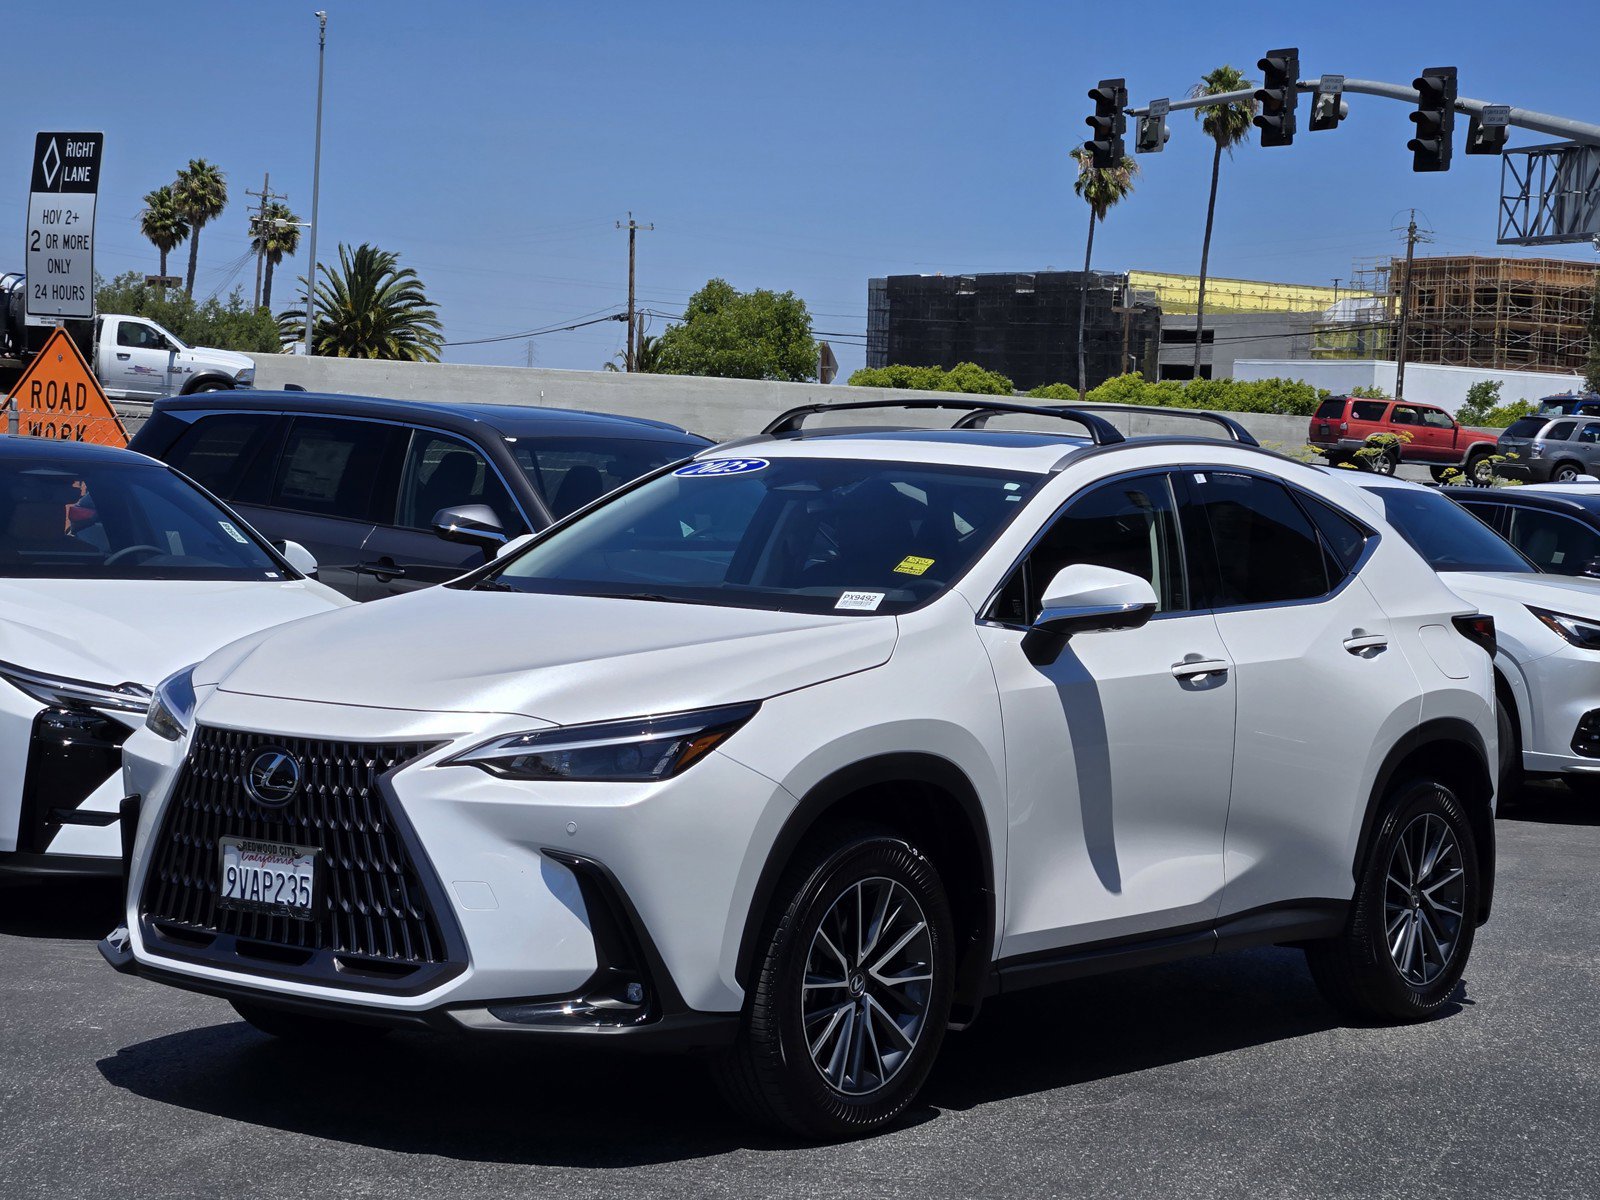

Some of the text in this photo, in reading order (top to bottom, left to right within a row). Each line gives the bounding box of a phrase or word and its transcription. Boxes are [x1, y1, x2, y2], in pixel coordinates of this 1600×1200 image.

[65, 141, 95, 158] RIGHT
[64, 166, 92, 182] LANE
[42, 209, 80, 225] HOV 2+
[30, 229, 90, 252] 2 OR MORE
[47, 258, 72, 274] ONLY
[34, 283, 85, 301] 24 HOURS
[30, 380, 87, 411] ROAD
[242, 841, 278, 855] REDWOOD
[225, 866, 310, 908] 9VAP235
